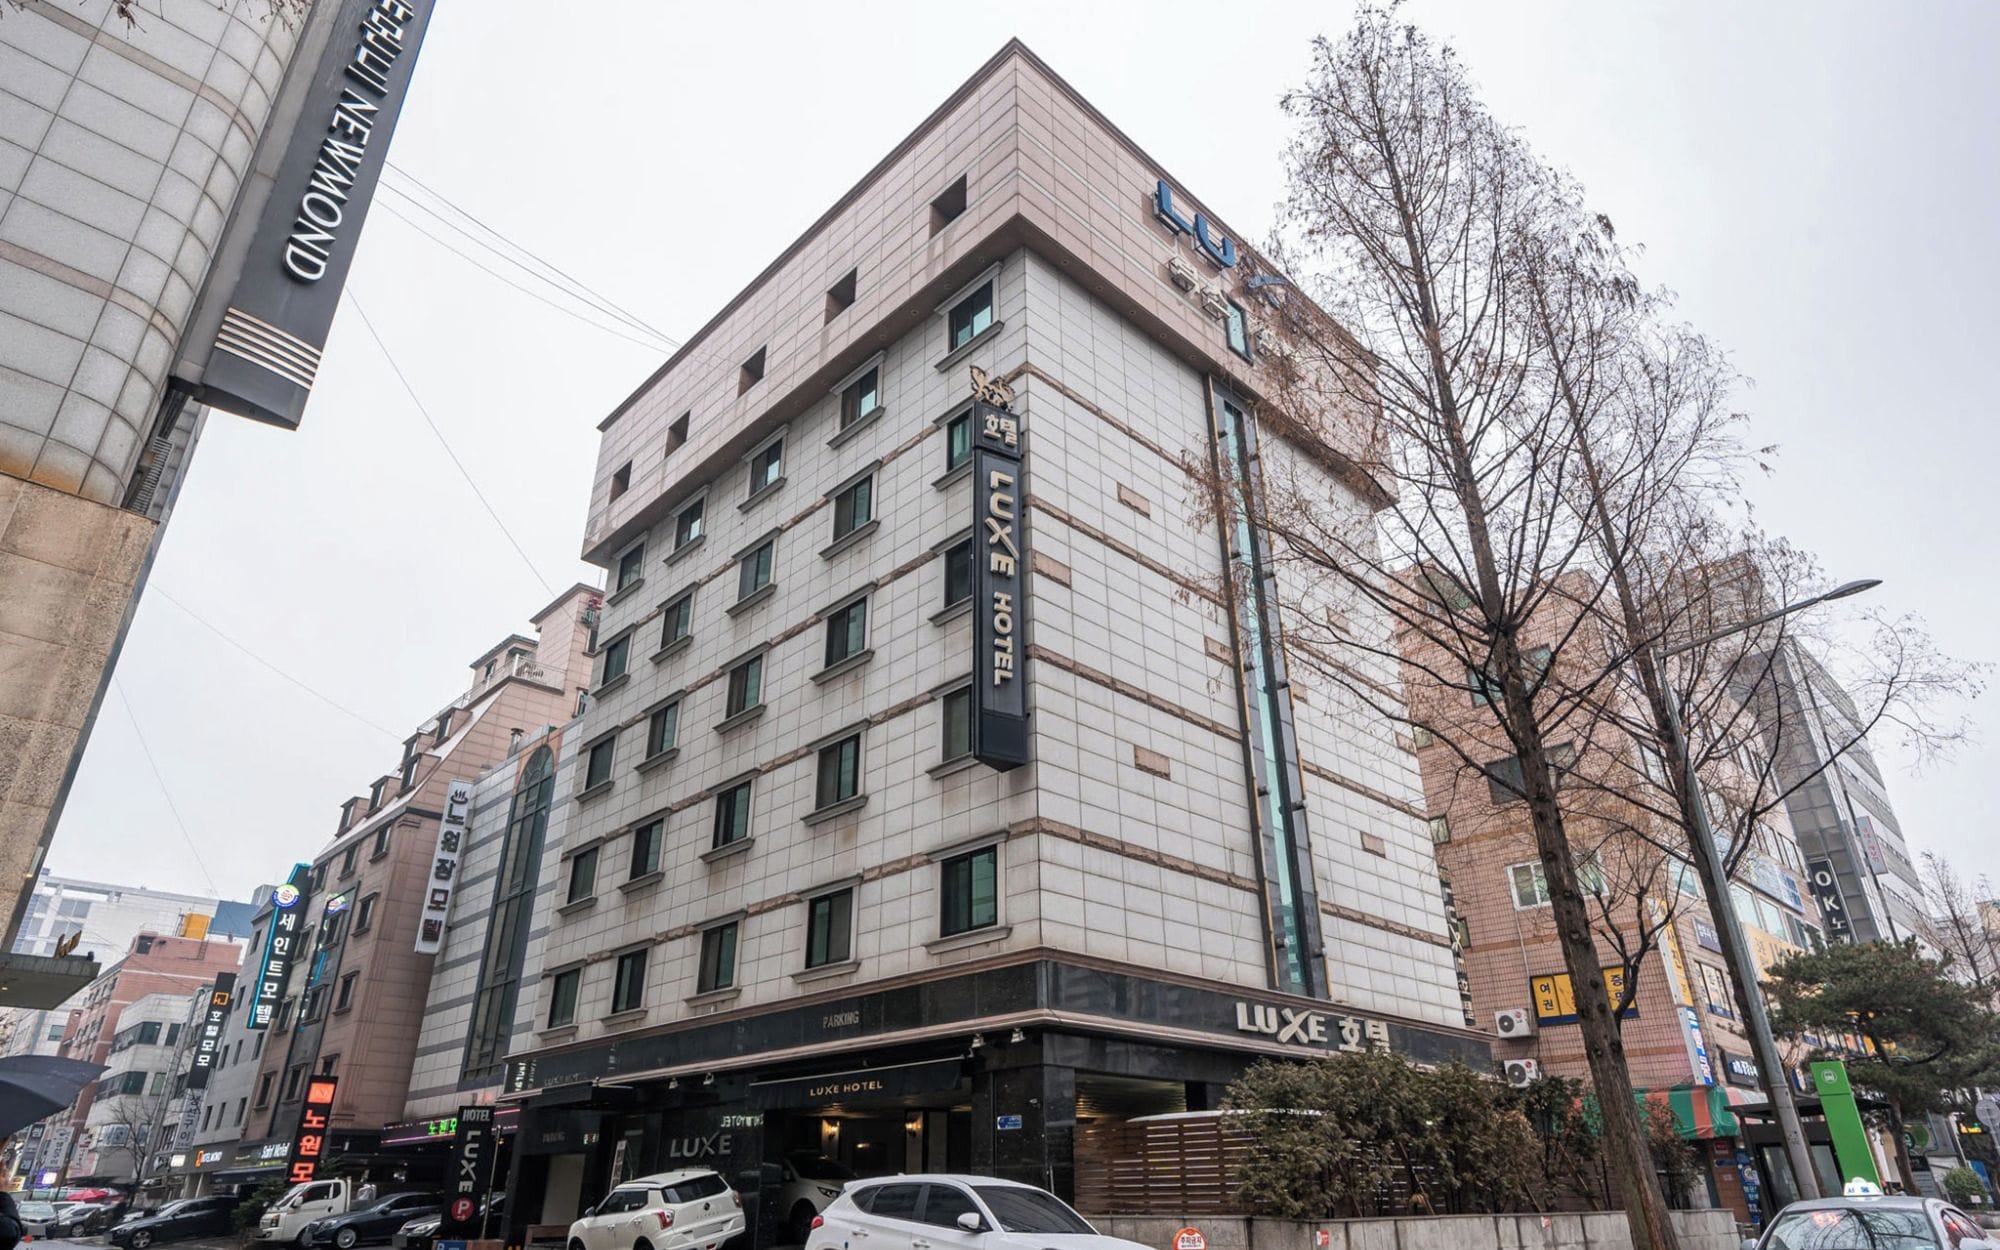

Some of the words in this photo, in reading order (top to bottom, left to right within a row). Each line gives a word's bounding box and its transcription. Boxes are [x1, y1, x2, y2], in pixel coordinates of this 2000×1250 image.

[284, 87, 380, 282] NEWMOND
[984, 413, 1018, 448] 호텔
[985, 470, 1020, 578] LUXE
[993, 591, 1014, 686] HOTEL
[421, 803, 465, 942] 노원장모텔
[255, 913, 297, 1024] 세인트모텔
[1539, 983, 1554, 1011] 여권
[822, 1010, 860, 1029] PARKING
[1236, 1002, 1328, 1044] LUXE
[1339, 1017, 1391, 1056] 호텔
[810, 1083, 840, 1097] LUXE
[843, 1080, 883, 1093] HOTEL
[462, 1109, 490, 1122] HOTEL
[459, 1130, 481, 1193] LUXE
[669, 1131, 732, 1158] LUXE
[458, 1200, 470, 1215] P
